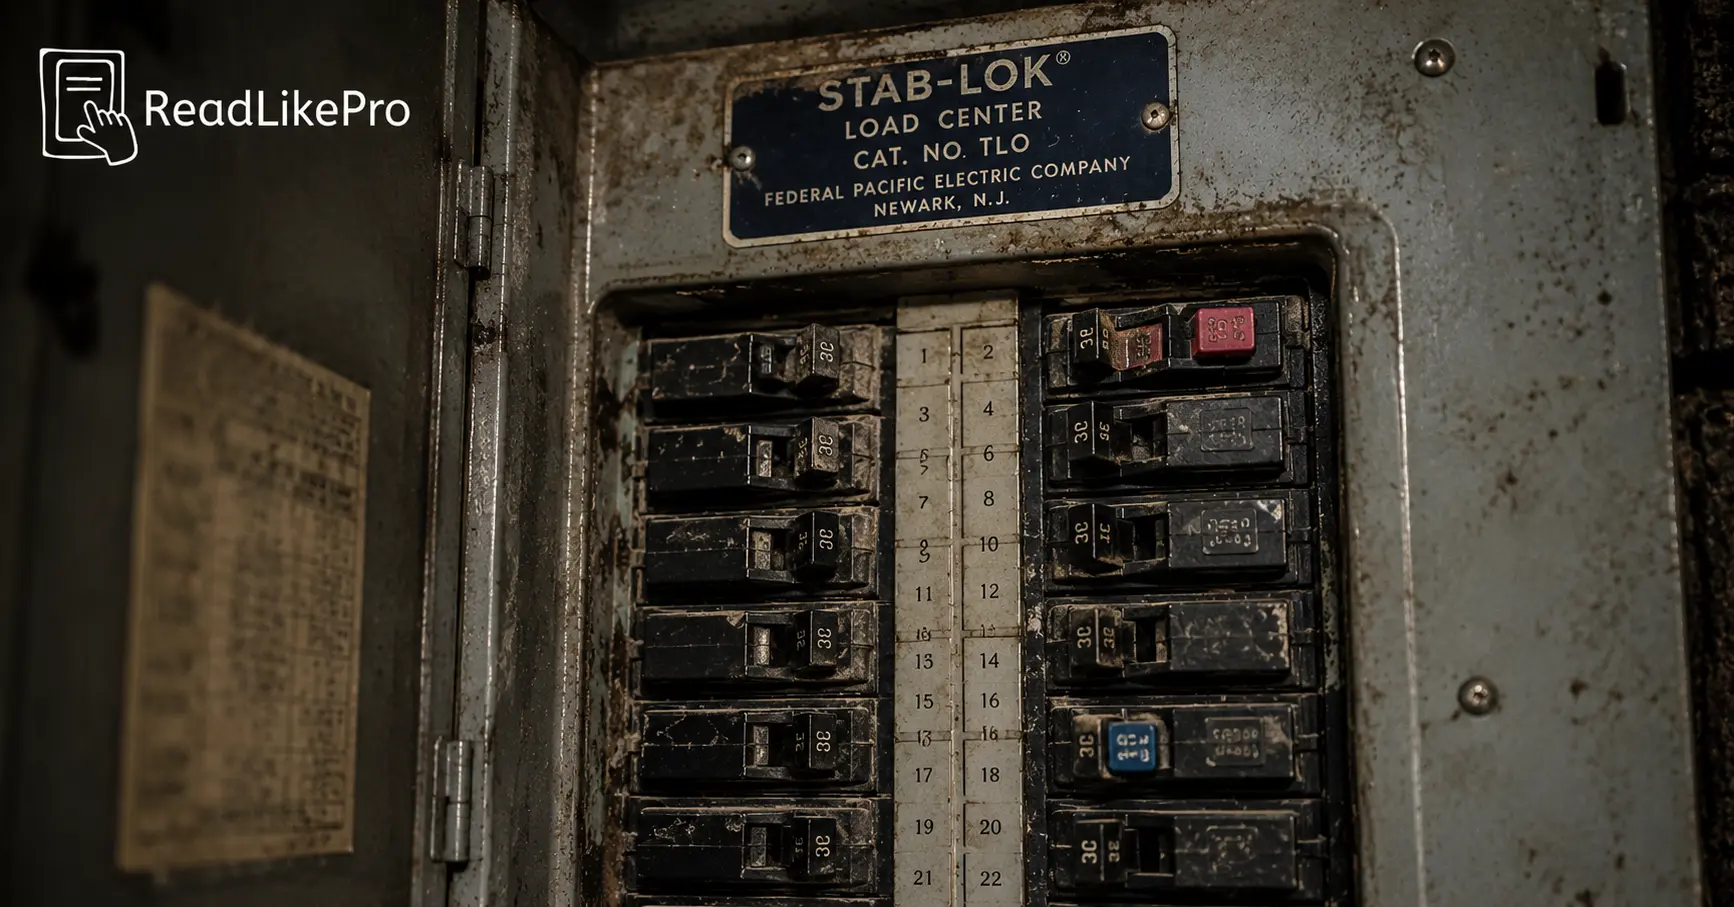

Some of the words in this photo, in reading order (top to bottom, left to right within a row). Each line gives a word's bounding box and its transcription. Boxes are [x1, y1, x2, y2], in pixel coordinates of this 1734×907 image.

[845, 114, 919, 139] LOAD
[938, 101, 1042, 129] CENTER
[854, 147, 908, 170] CAT.
[923, 141, 967, 163] NO.
[979, 133, 1030, 157] TLO
[765, 185, 844, 206] FEDERAL
[853, 176, 925, 197] PACIFIC
[935, 166, 1021, 189] ELECTRIC
[1031, 156, 1131, 179] COMPANY
[874, 196, 961, 217] NEWARK,
[921, 349, 927, 363] 1
[983, 345, 994, 359] 2
[919, 406, 929, 422] 3
[983, 401, 994, 416] 4
[983, 445, 994, 461] 6
[919, 496, 928, 509] 7
[983, 490, 995, 506] 8
[980, 536, 999, 552] 10
[916, 587, 932, 601] 11
[981, 583, 999, 599] 12
[915, 653, 933, 669] 13
[980, 652, 999, 668] 14
[915, 694, 933, 709] 15
[981, 692, 999, 708] 16
[915, 767, 933, 782] 17
[981, 767, 1000, 782] 18
[915, 819, 934, 834] 19
[980, 819, 1001, 834] 20
[913, 870, 932, 885] 21
[980, 871, 1001, 886] 22
